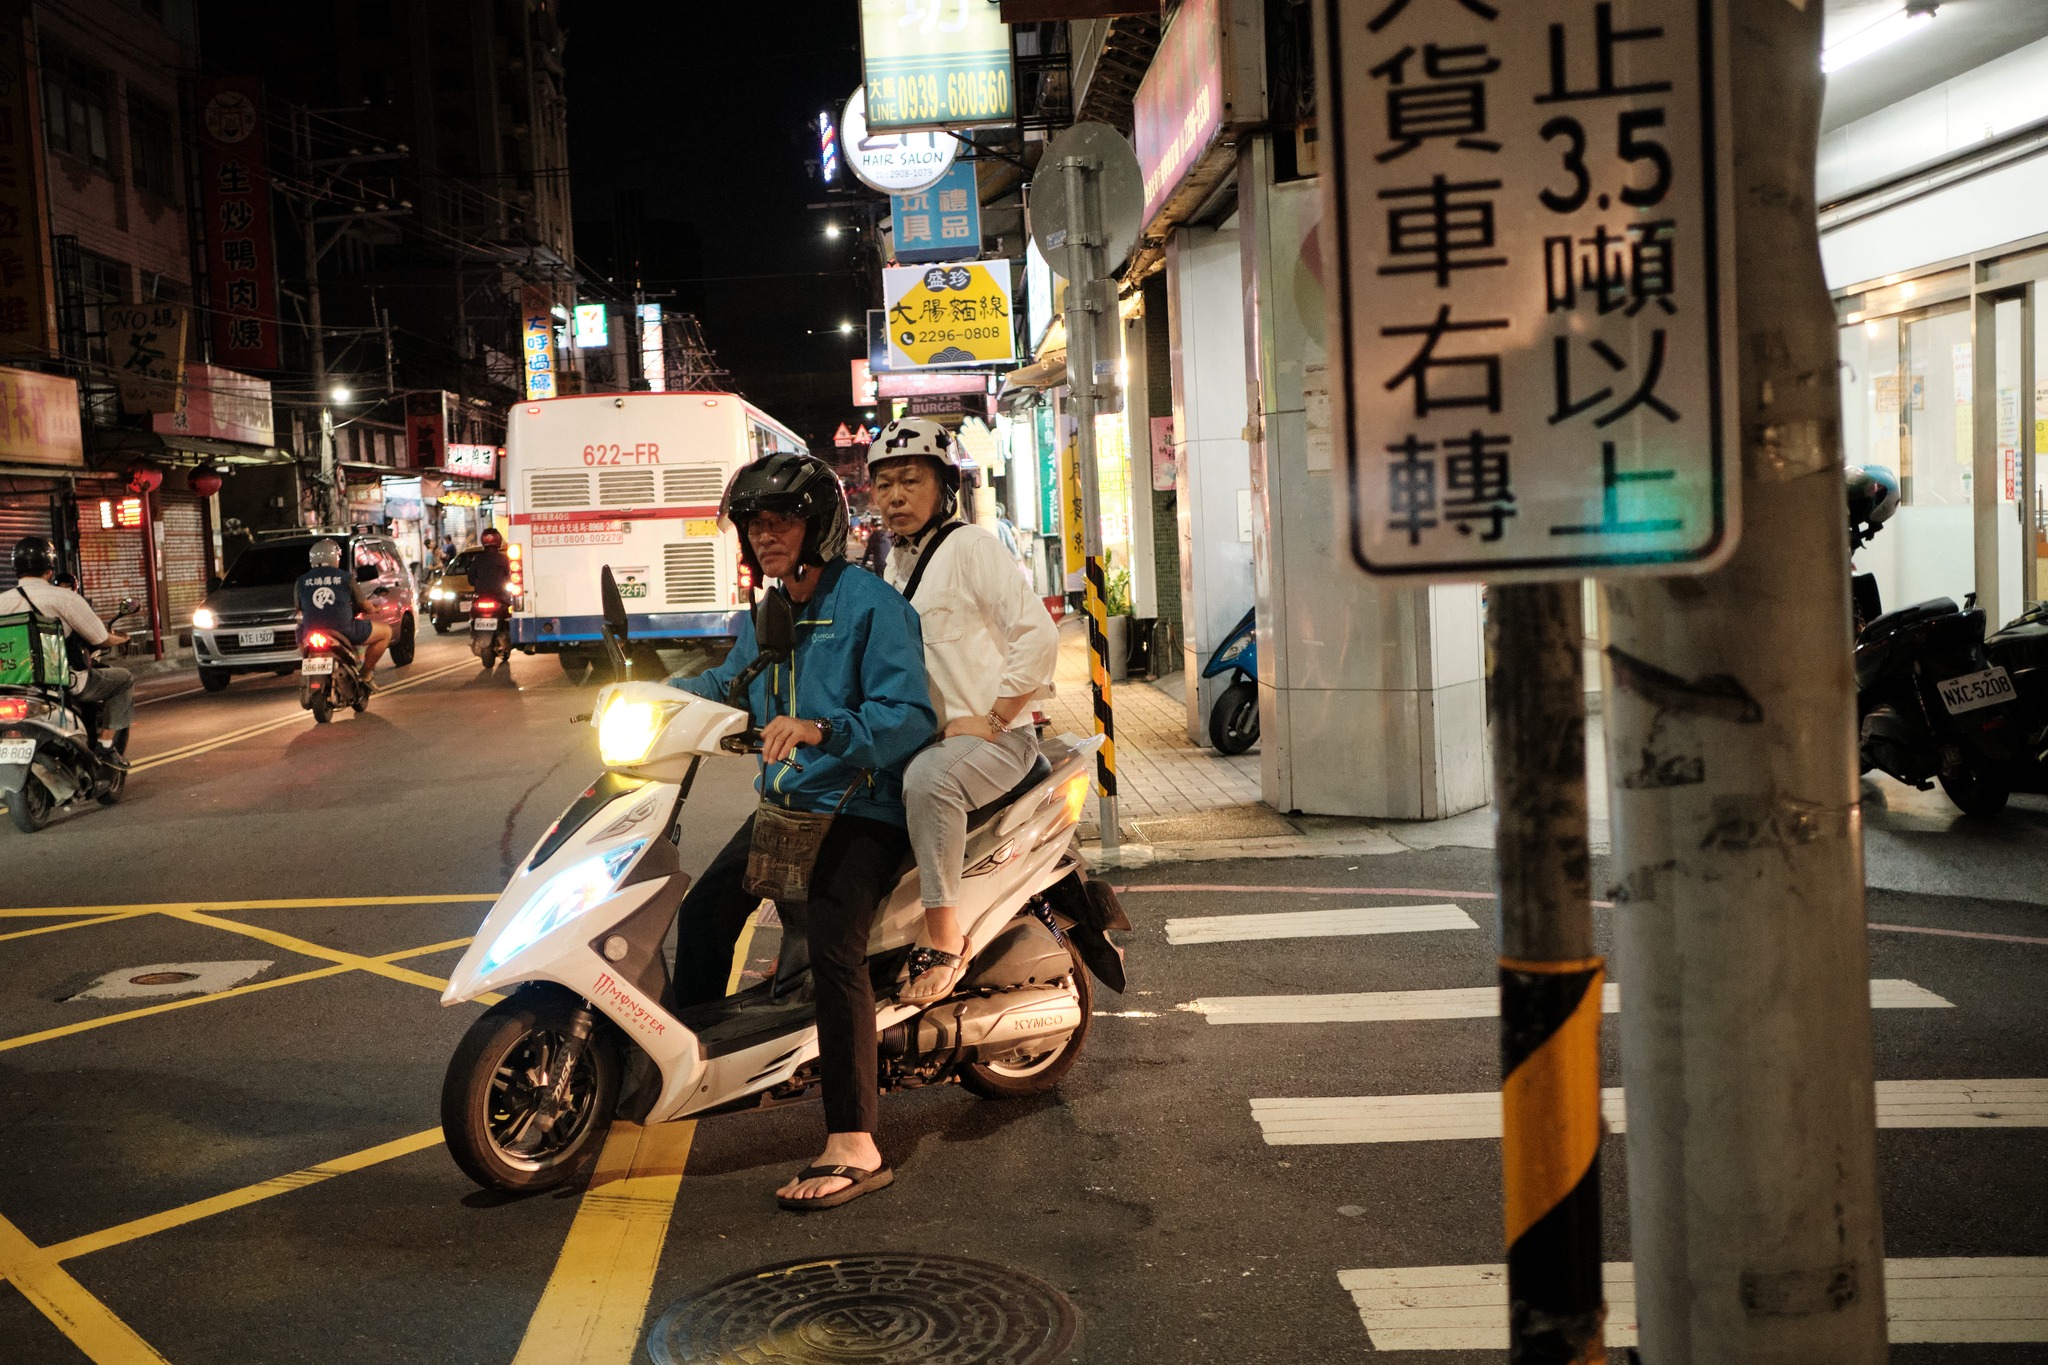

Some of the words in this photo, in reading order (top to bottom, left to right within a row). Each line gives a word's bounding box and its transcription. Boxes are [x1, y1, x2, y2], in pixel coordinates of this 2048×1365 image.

[898, 69, 1008, 120] 0939-680560
[869, 102, 898, 122] LINE
[863, 154, 894, 166] HAIR
[900, 152, 943, 166] SALON
[938, 189, 970, 239] 禮品
[1364, 0, 1519, 548] 貨車右轉
[889, 295, 1009, 325] 大腸麵線
[919, 326, 1000, 343] 2296-0808
[526, 315, 551, 391] 大呼過癮
[912, 402, 961, 414] BURGER
[583, 443, 660, 466] 622-FR
[1942, 676, 2012, 706] NXC-5208
[609, 1000, 652, 1035] ENERGY
[1014, 1015, 1063, 1031] KYMCO
